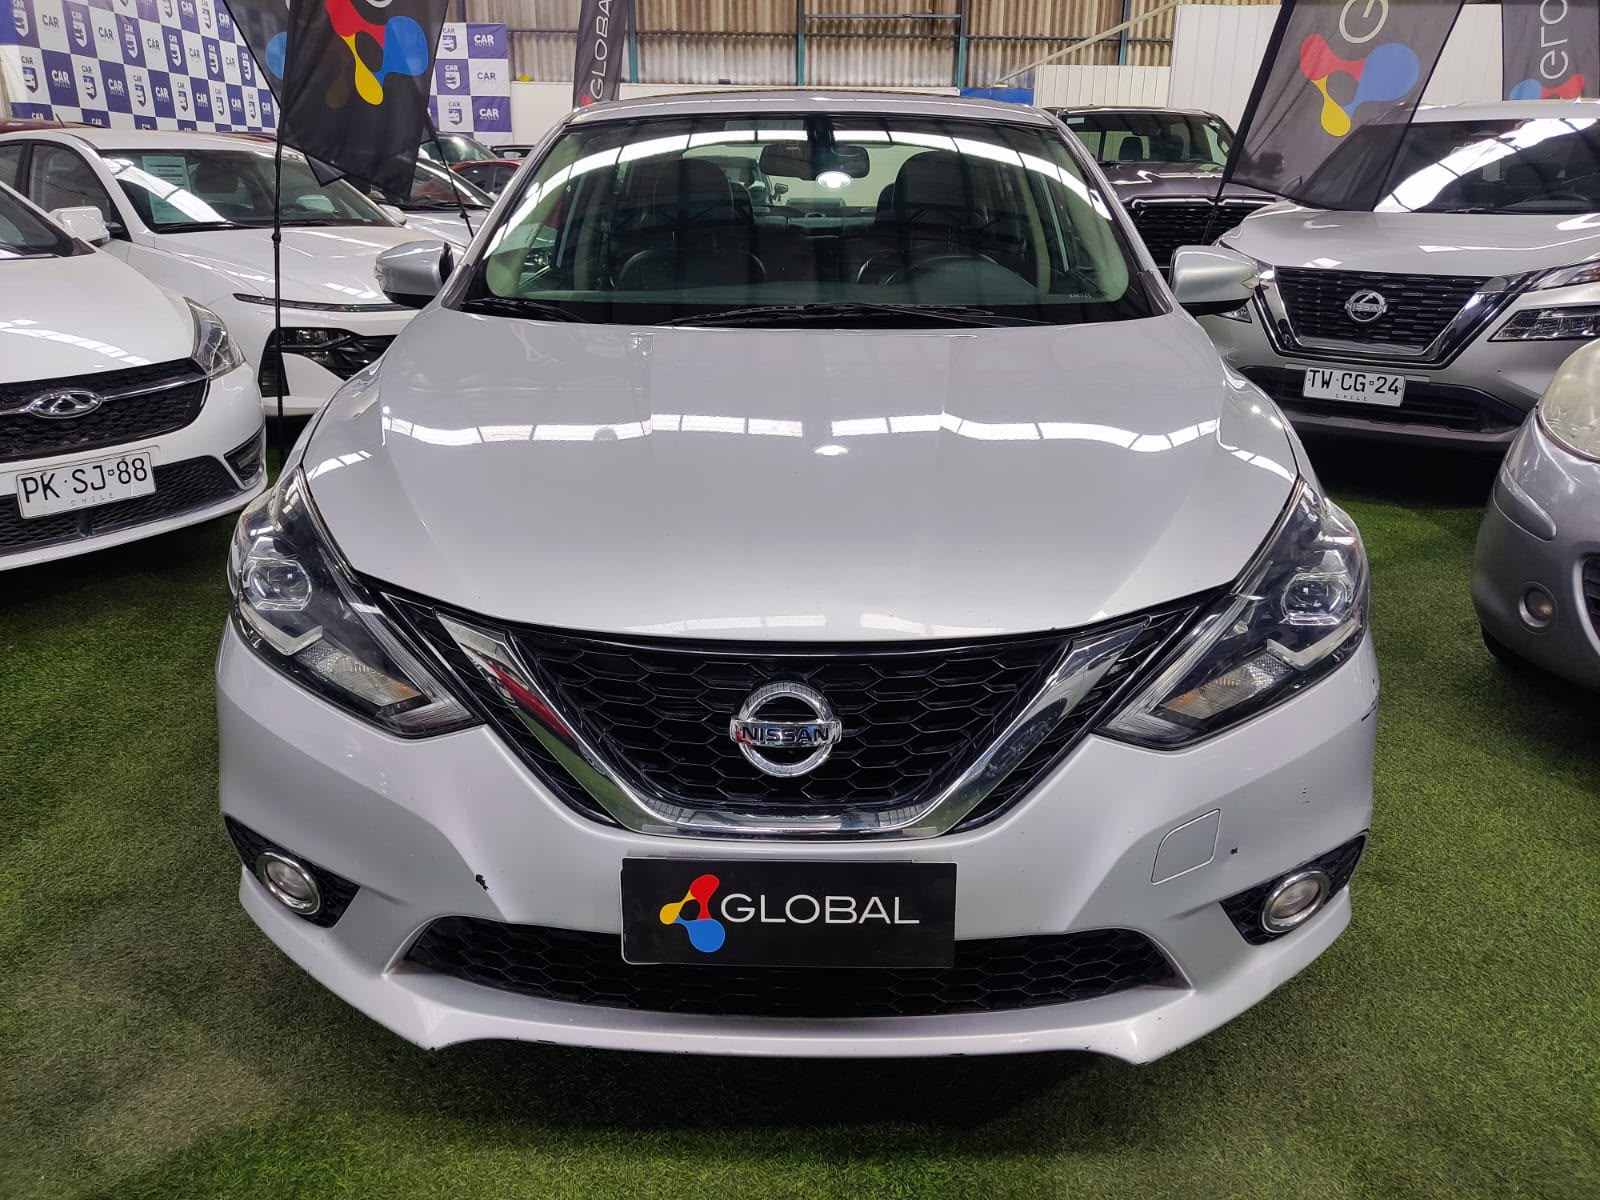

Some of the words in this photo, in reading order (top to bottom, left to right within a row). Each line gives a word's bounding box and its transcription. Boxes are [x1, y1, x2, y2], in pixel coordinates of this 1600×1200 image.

[42, 14, 60, 28] CAR
[98, 27, 114, 40] CAR
[474, 35, 494, 44] CAR
[147, 38, 160, 51] CAR
[21, 56, 34, 65] CAR
[52, 70, 70, 84] CAR
[477, 72, 496, 81] CAR
[108, 79, 124, 92] CAR
[155, 86, 169, 99] CAR
[479, 108, 499, 117] CAR
[741, 726, 829, 743] NISSAN
[720, 893, 921, 925] GLOBAL
